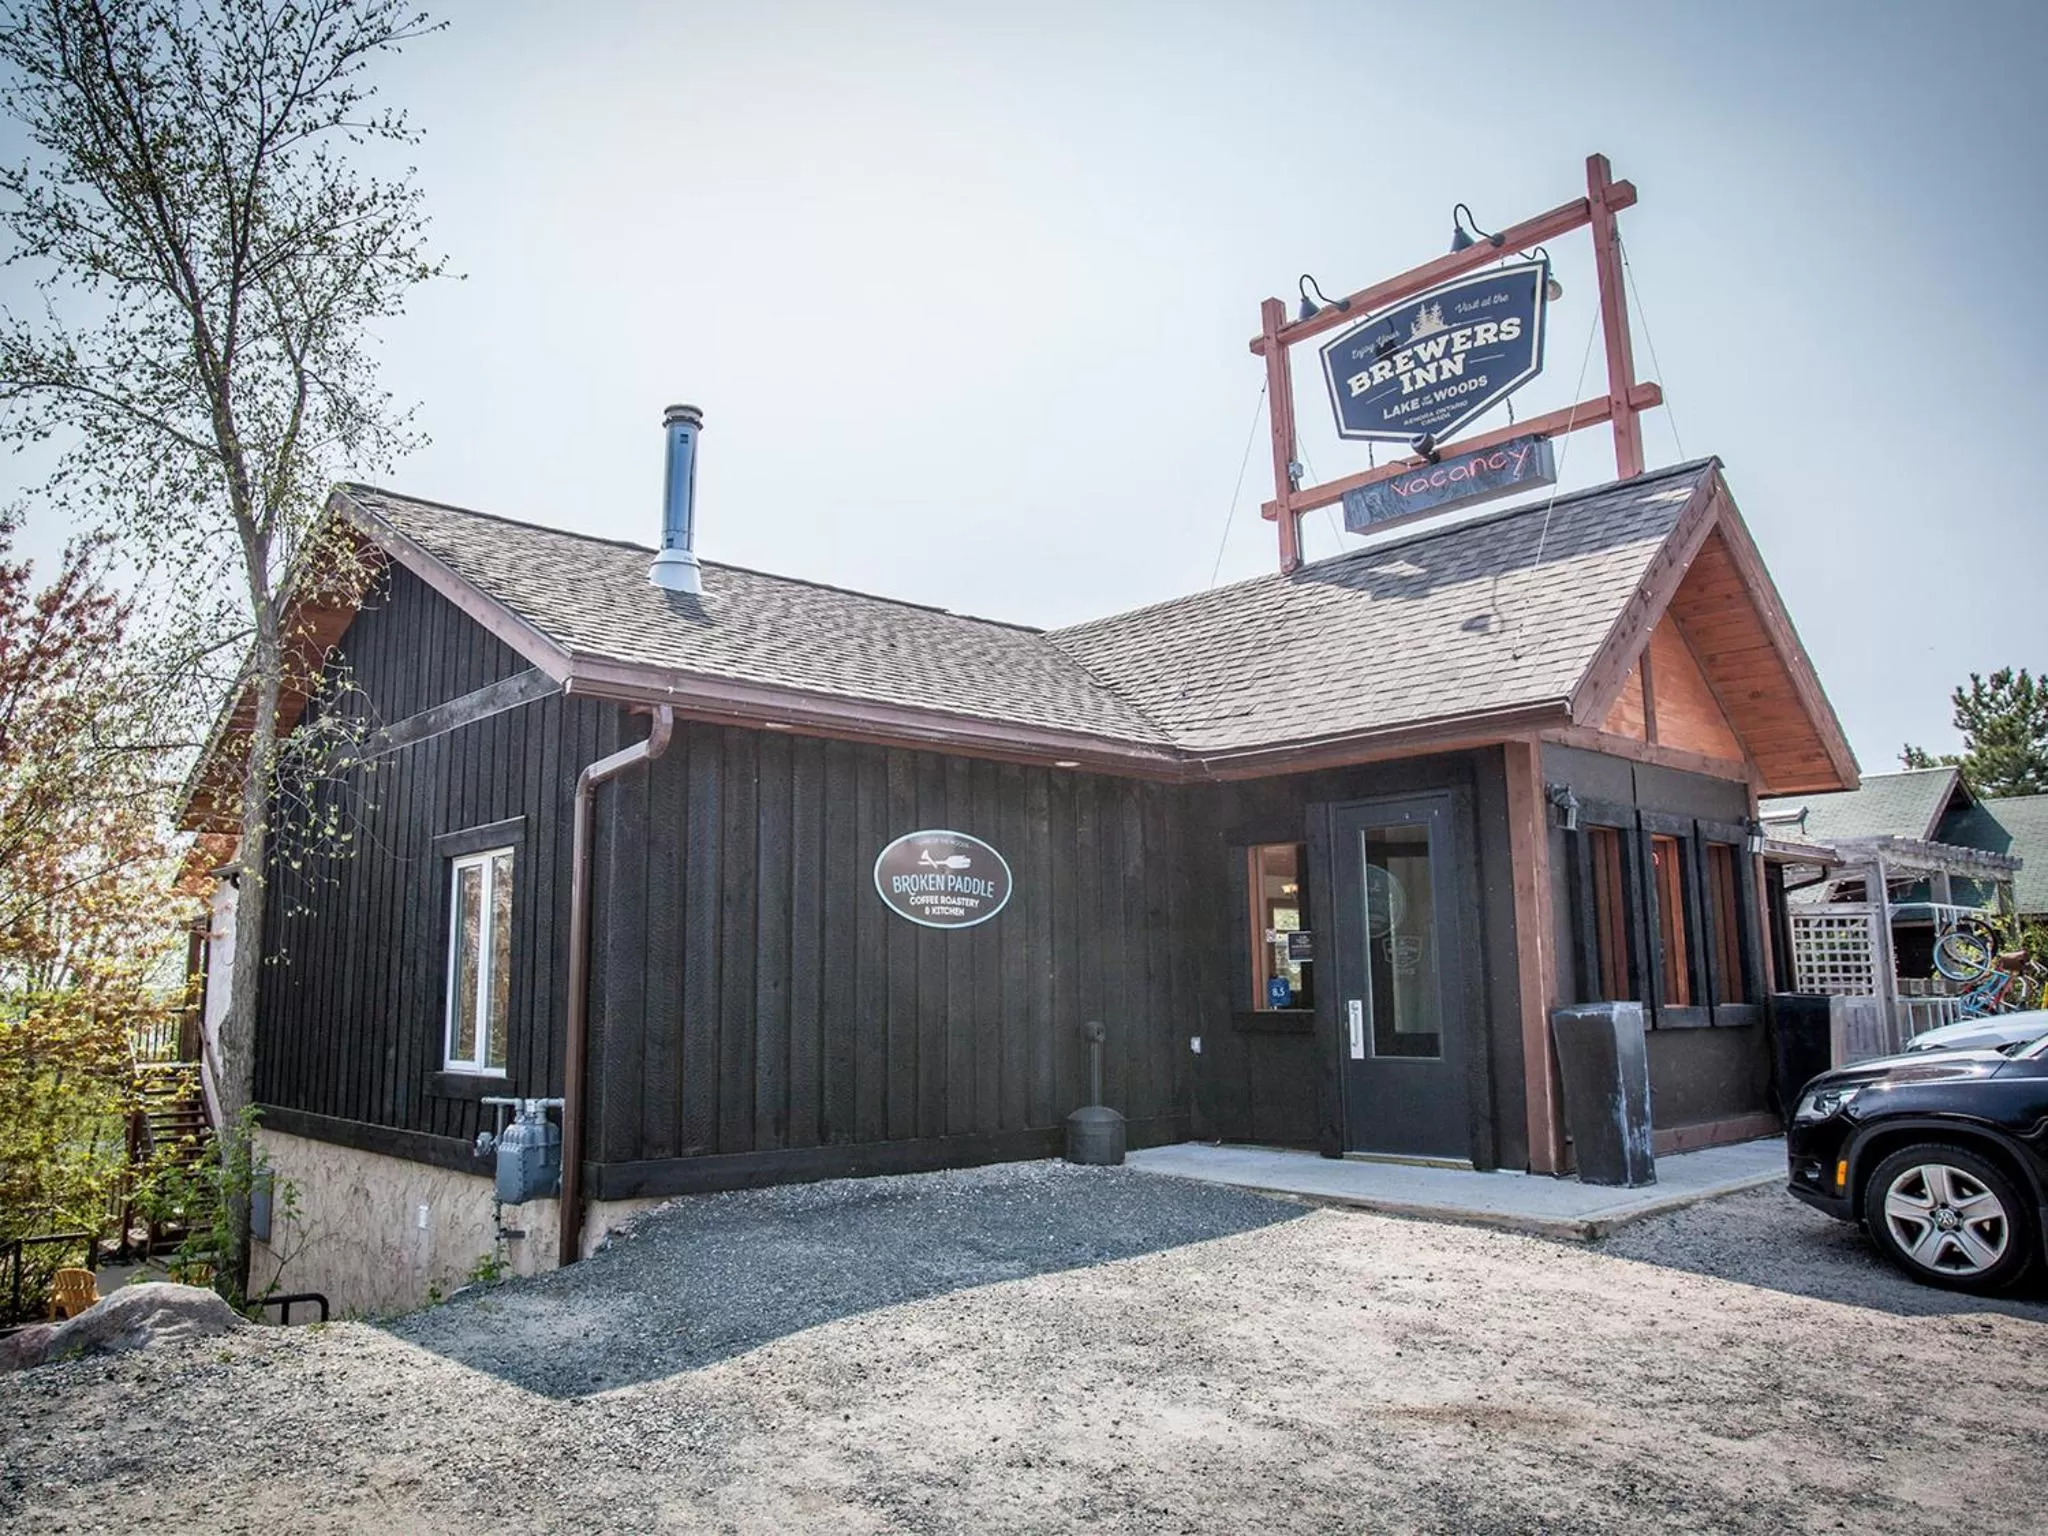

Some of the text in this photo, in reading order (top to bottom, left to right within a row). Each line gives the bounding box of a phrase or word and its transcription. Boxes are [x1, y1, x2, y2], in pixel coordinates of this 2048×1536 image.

[1347, 317, 1521, 397] BREWERS
[1399, 353, 1466, 395] INN
[1383, 398, 1421, 420] LAKE
[1433, 375, 1488, 402] WOODS
[1391, 443, 1530, 497] vacancy
[892, 874, 995, 898] BROKEN PADDLE
[909, 895, 980, 909] COFFEE ROASTERY
[931, 906, 965, 917] KITCHEN
